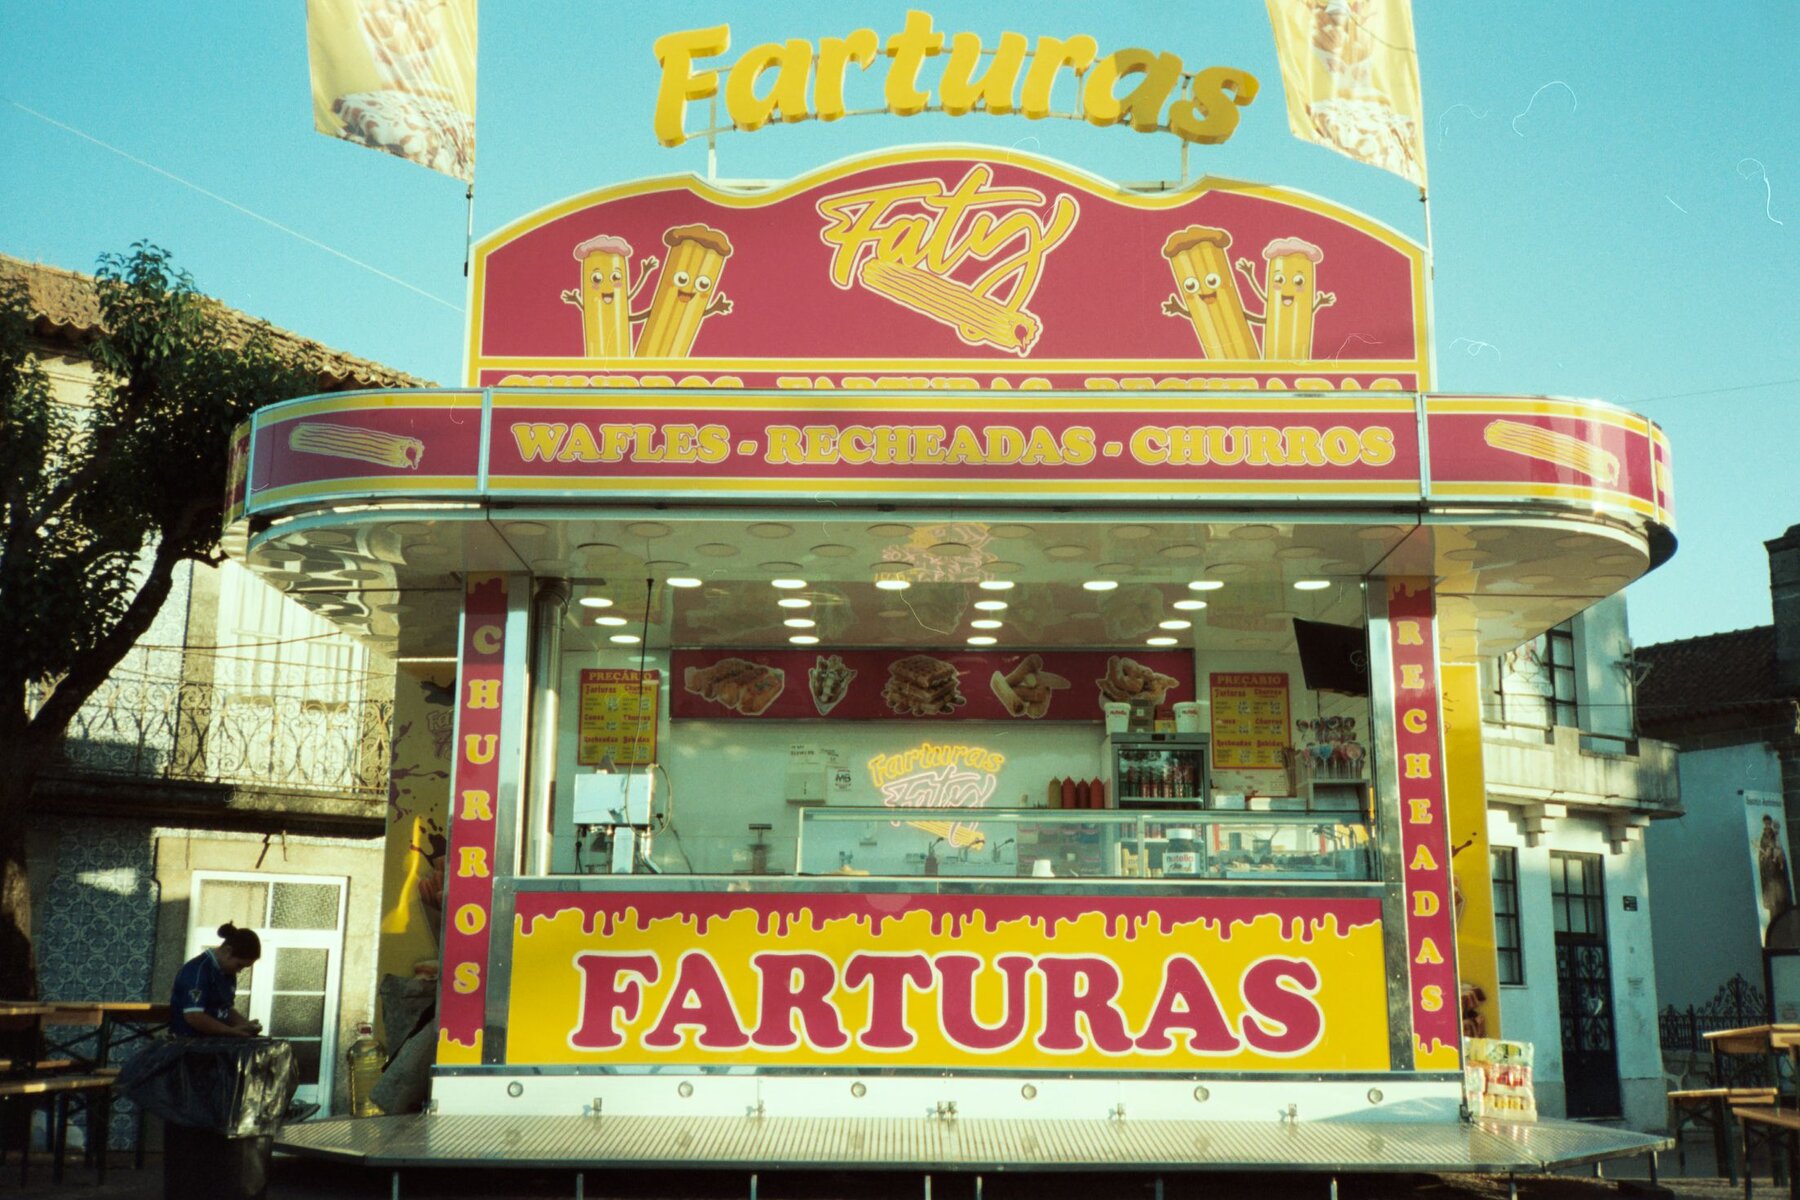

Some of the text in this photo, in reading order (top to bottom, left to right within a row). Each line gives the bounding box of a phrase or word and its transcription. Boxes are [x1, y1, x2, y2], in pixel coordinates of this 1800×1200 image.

[653, 9, 1260, 148] Farturas
[816, 163, 1080, 342] Faty
[511, 423, 730, 465] WAFLES
[764, 424, 1096, 466] RECHEADAS
[1130, 425, 1396, 467] CHURROS
[590, 671, 651, 683] PREÇÁRO
[453, 623, 503, 995] CHURROS
[868, 744, 1004, 786] Farturas
[1396, 620, 1444, 1013] RECHEADAS
[1166, 854, 1194, 863] nutella
[567, 948, 1326, 1058] FARTURAS
